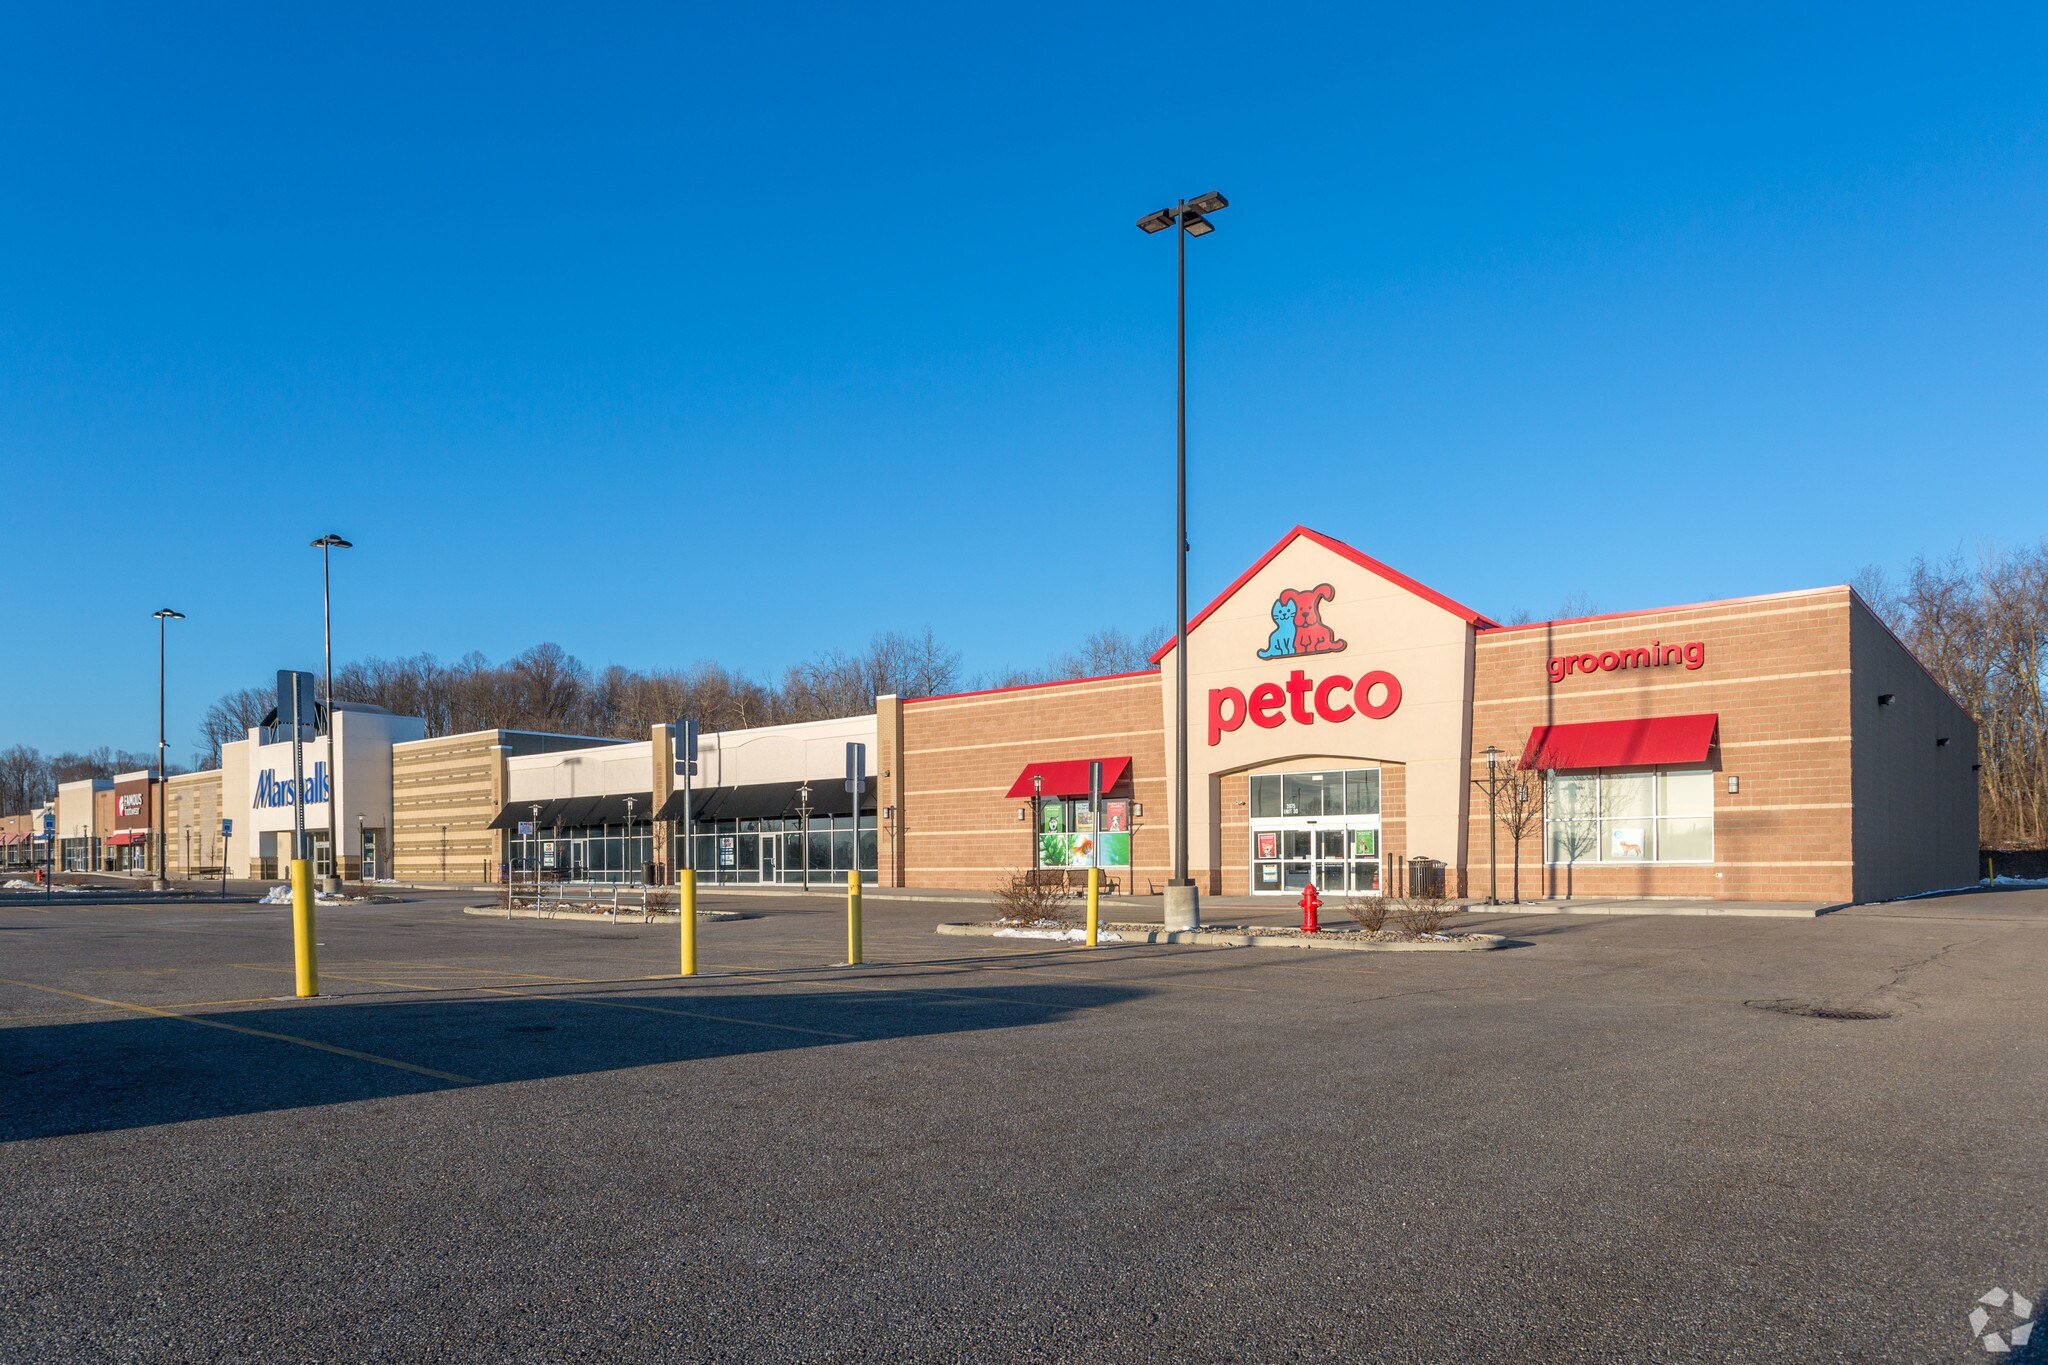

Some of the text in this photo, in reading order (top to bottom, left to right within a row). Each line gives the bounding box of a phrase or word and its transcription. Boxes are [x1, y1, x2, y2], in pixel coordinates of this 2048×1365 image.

[1546, 640, 1705, 683] grooming
[1208, 669, 1403, 747] petco
[252, 761, 329, 809] Marsalls
